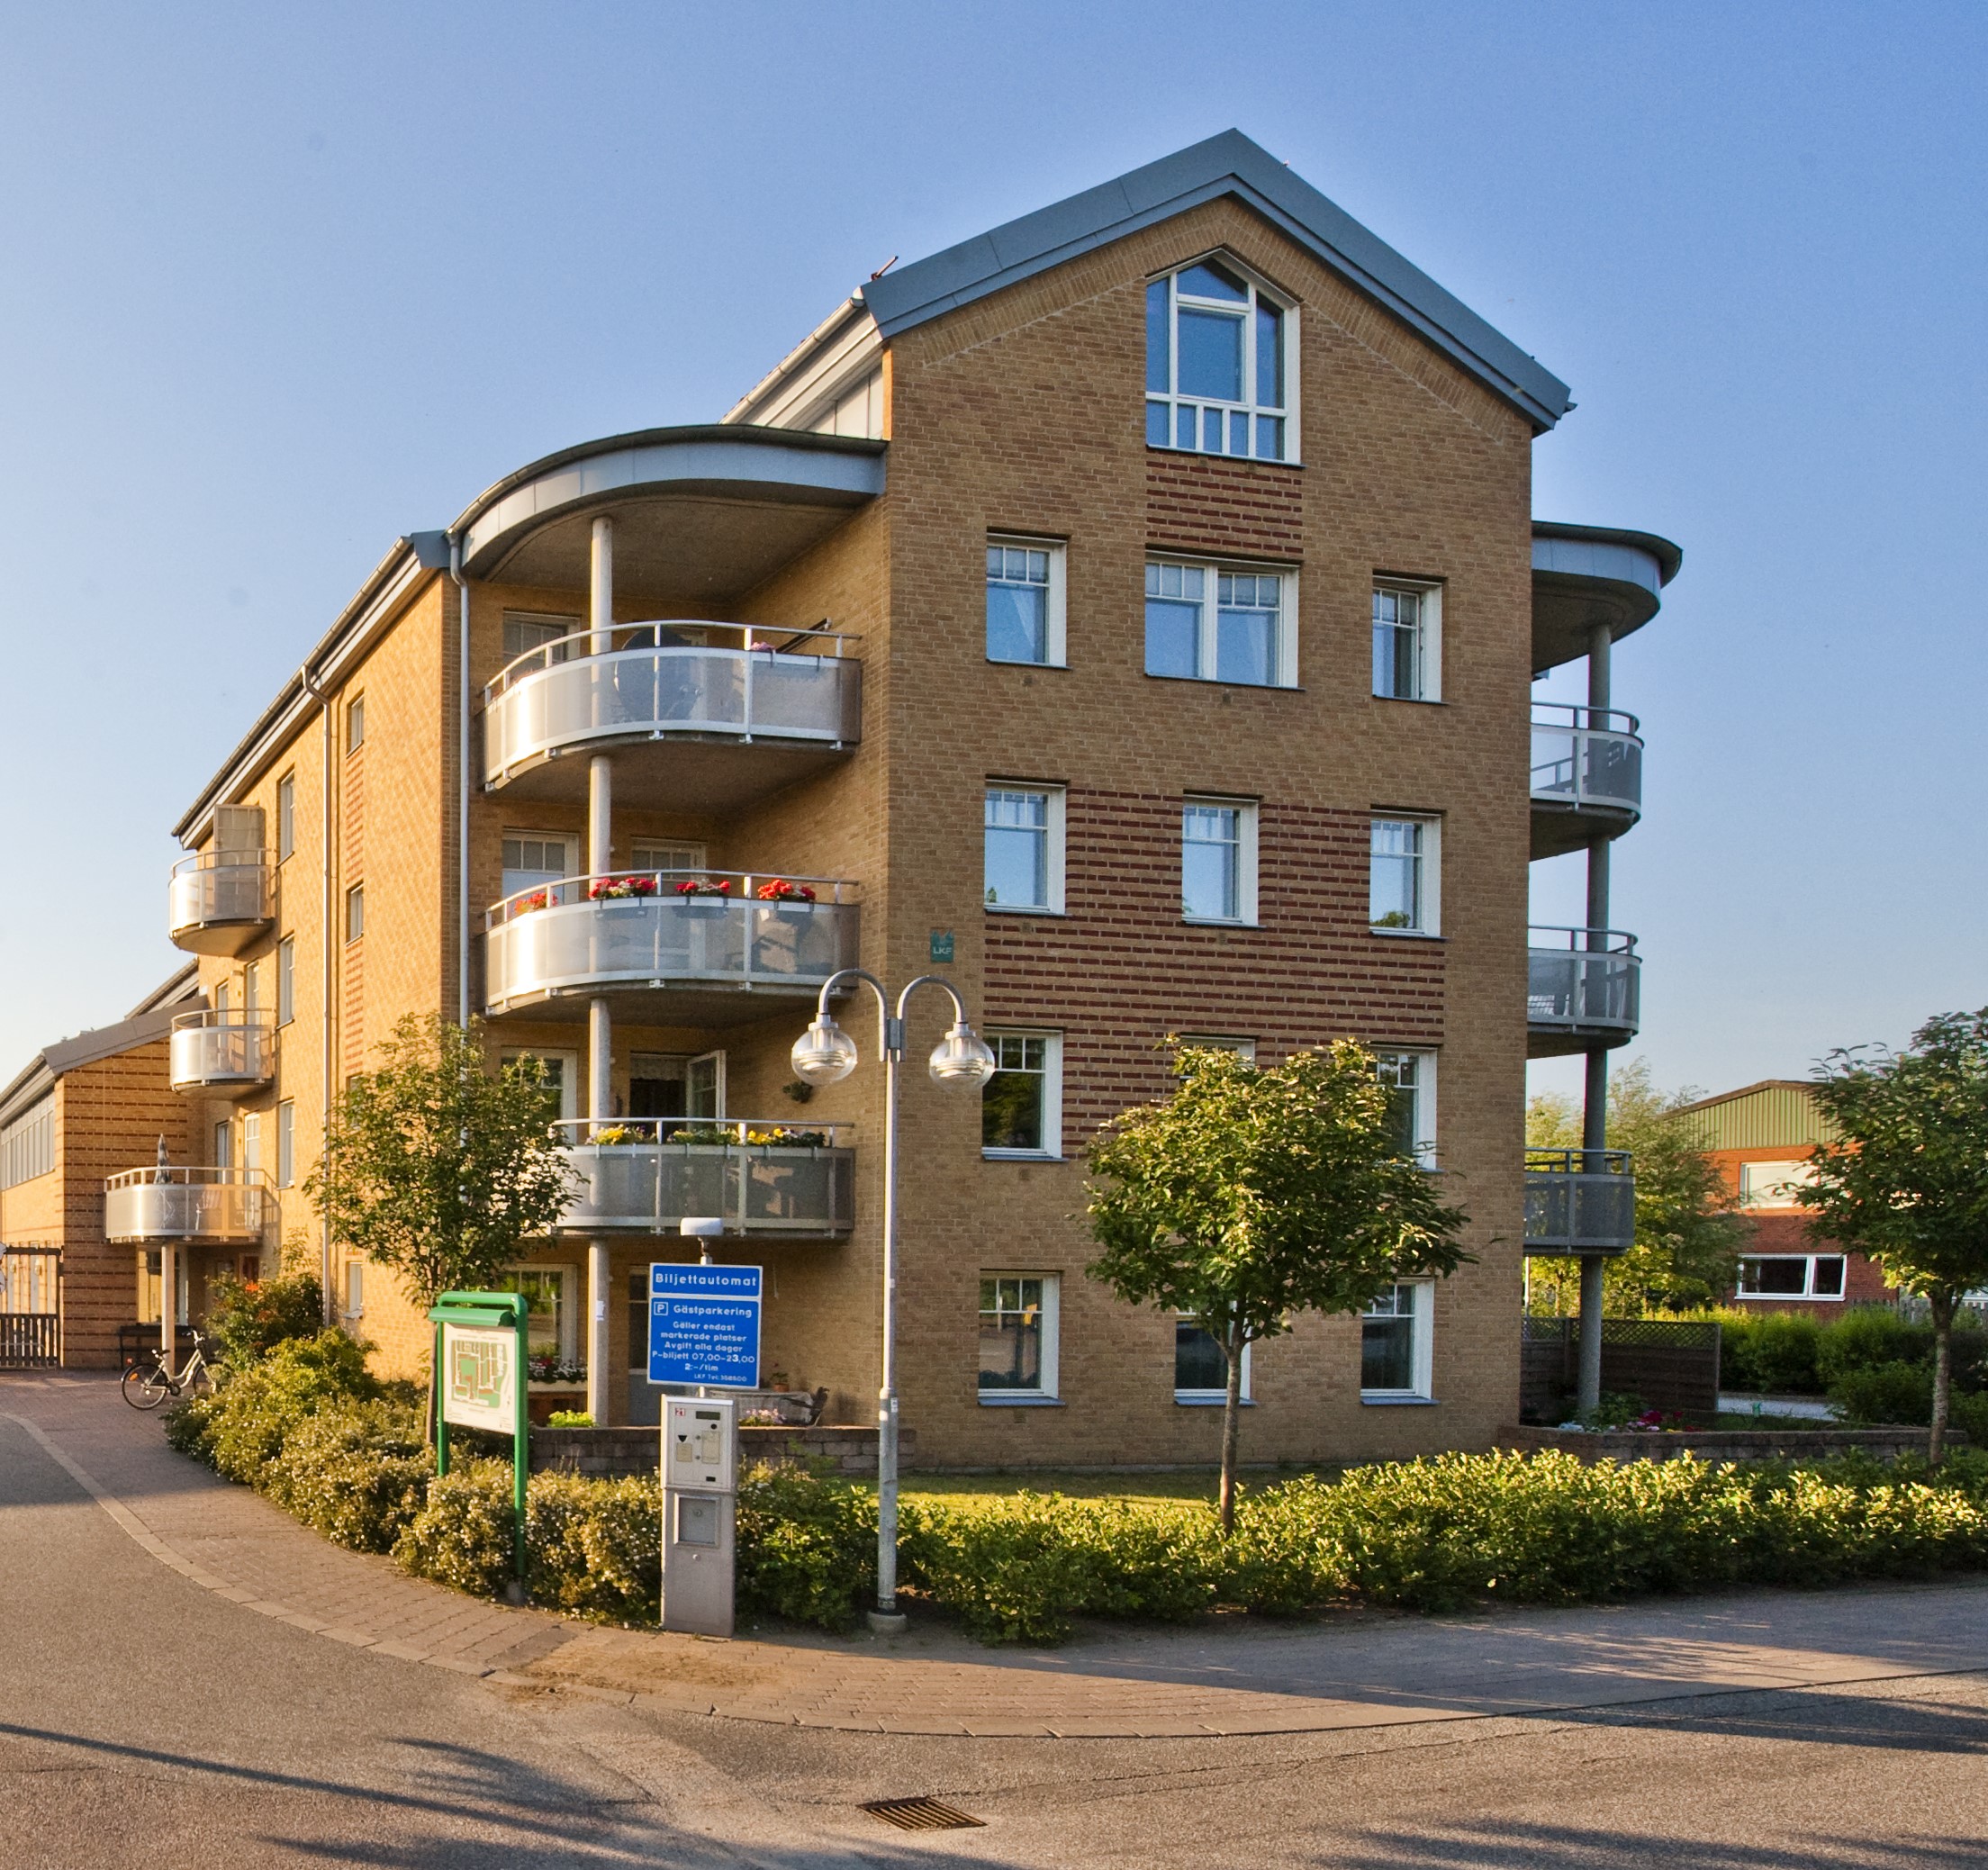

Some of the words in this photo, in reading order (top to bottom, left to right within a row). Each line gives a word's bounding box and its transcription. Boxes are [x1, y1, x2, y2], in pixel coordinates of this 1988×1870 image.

[655, 1273, 756, 1287] Biljettautomat
[673, 1305, 752, 1318] Gästparkering
[673, 1321, 700, 1330] Gäller
[703, 1323, 736, 1332] endast
[661, 1332, 710, 1341] markerade
[713, 1333, 747, 1342] platser
[664, 1342, 691, 1351] Avgift
[694, 1342, 712, 1351] alla
[715, 1344, 743, 1353] dagar
[652, 1351, 689, 1360] P-biljett
